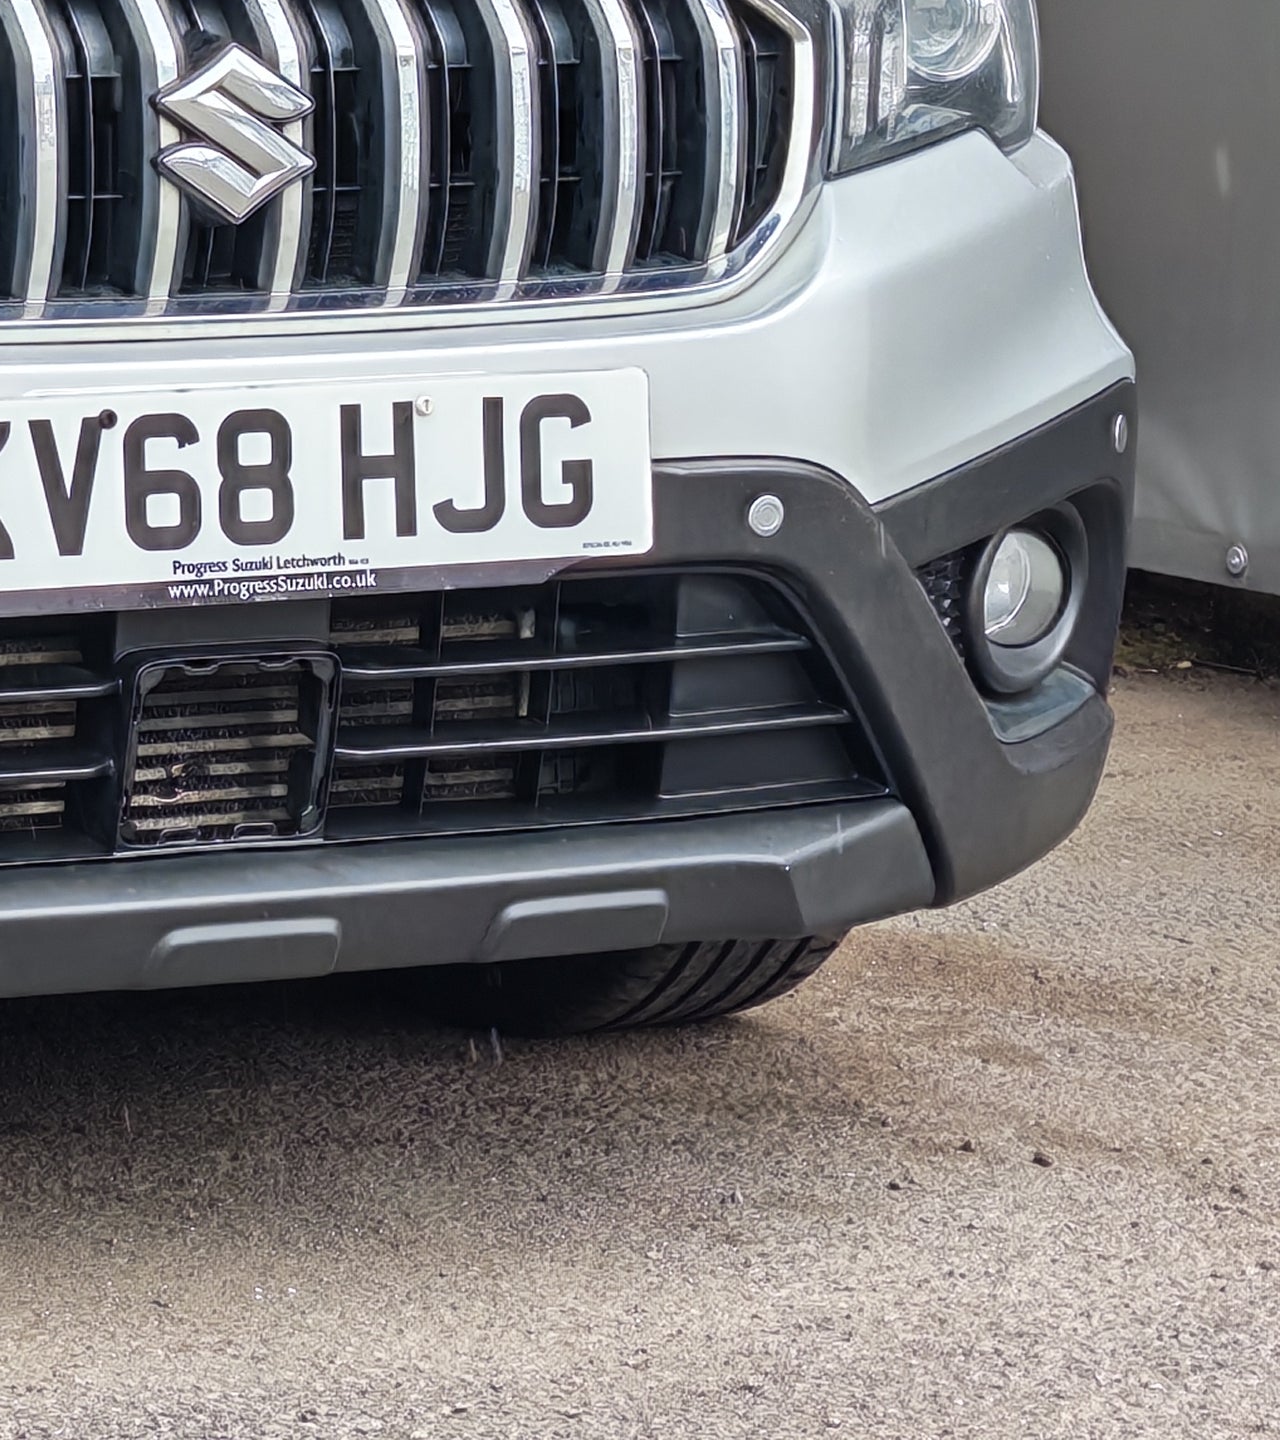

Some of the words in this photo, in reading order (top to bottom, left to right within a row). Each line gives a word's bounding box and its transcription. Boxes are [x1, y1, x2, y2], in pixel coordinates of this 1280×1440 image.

[339, 393, 594, 541] HJG
[172, 560, 228, 577] Progress
[232, 556, 273, 572] Suzuki
[276, 552, 345, 569] Letchworth
[168, 570, 377, 600] www.ProgressSuzuki.co.uk
